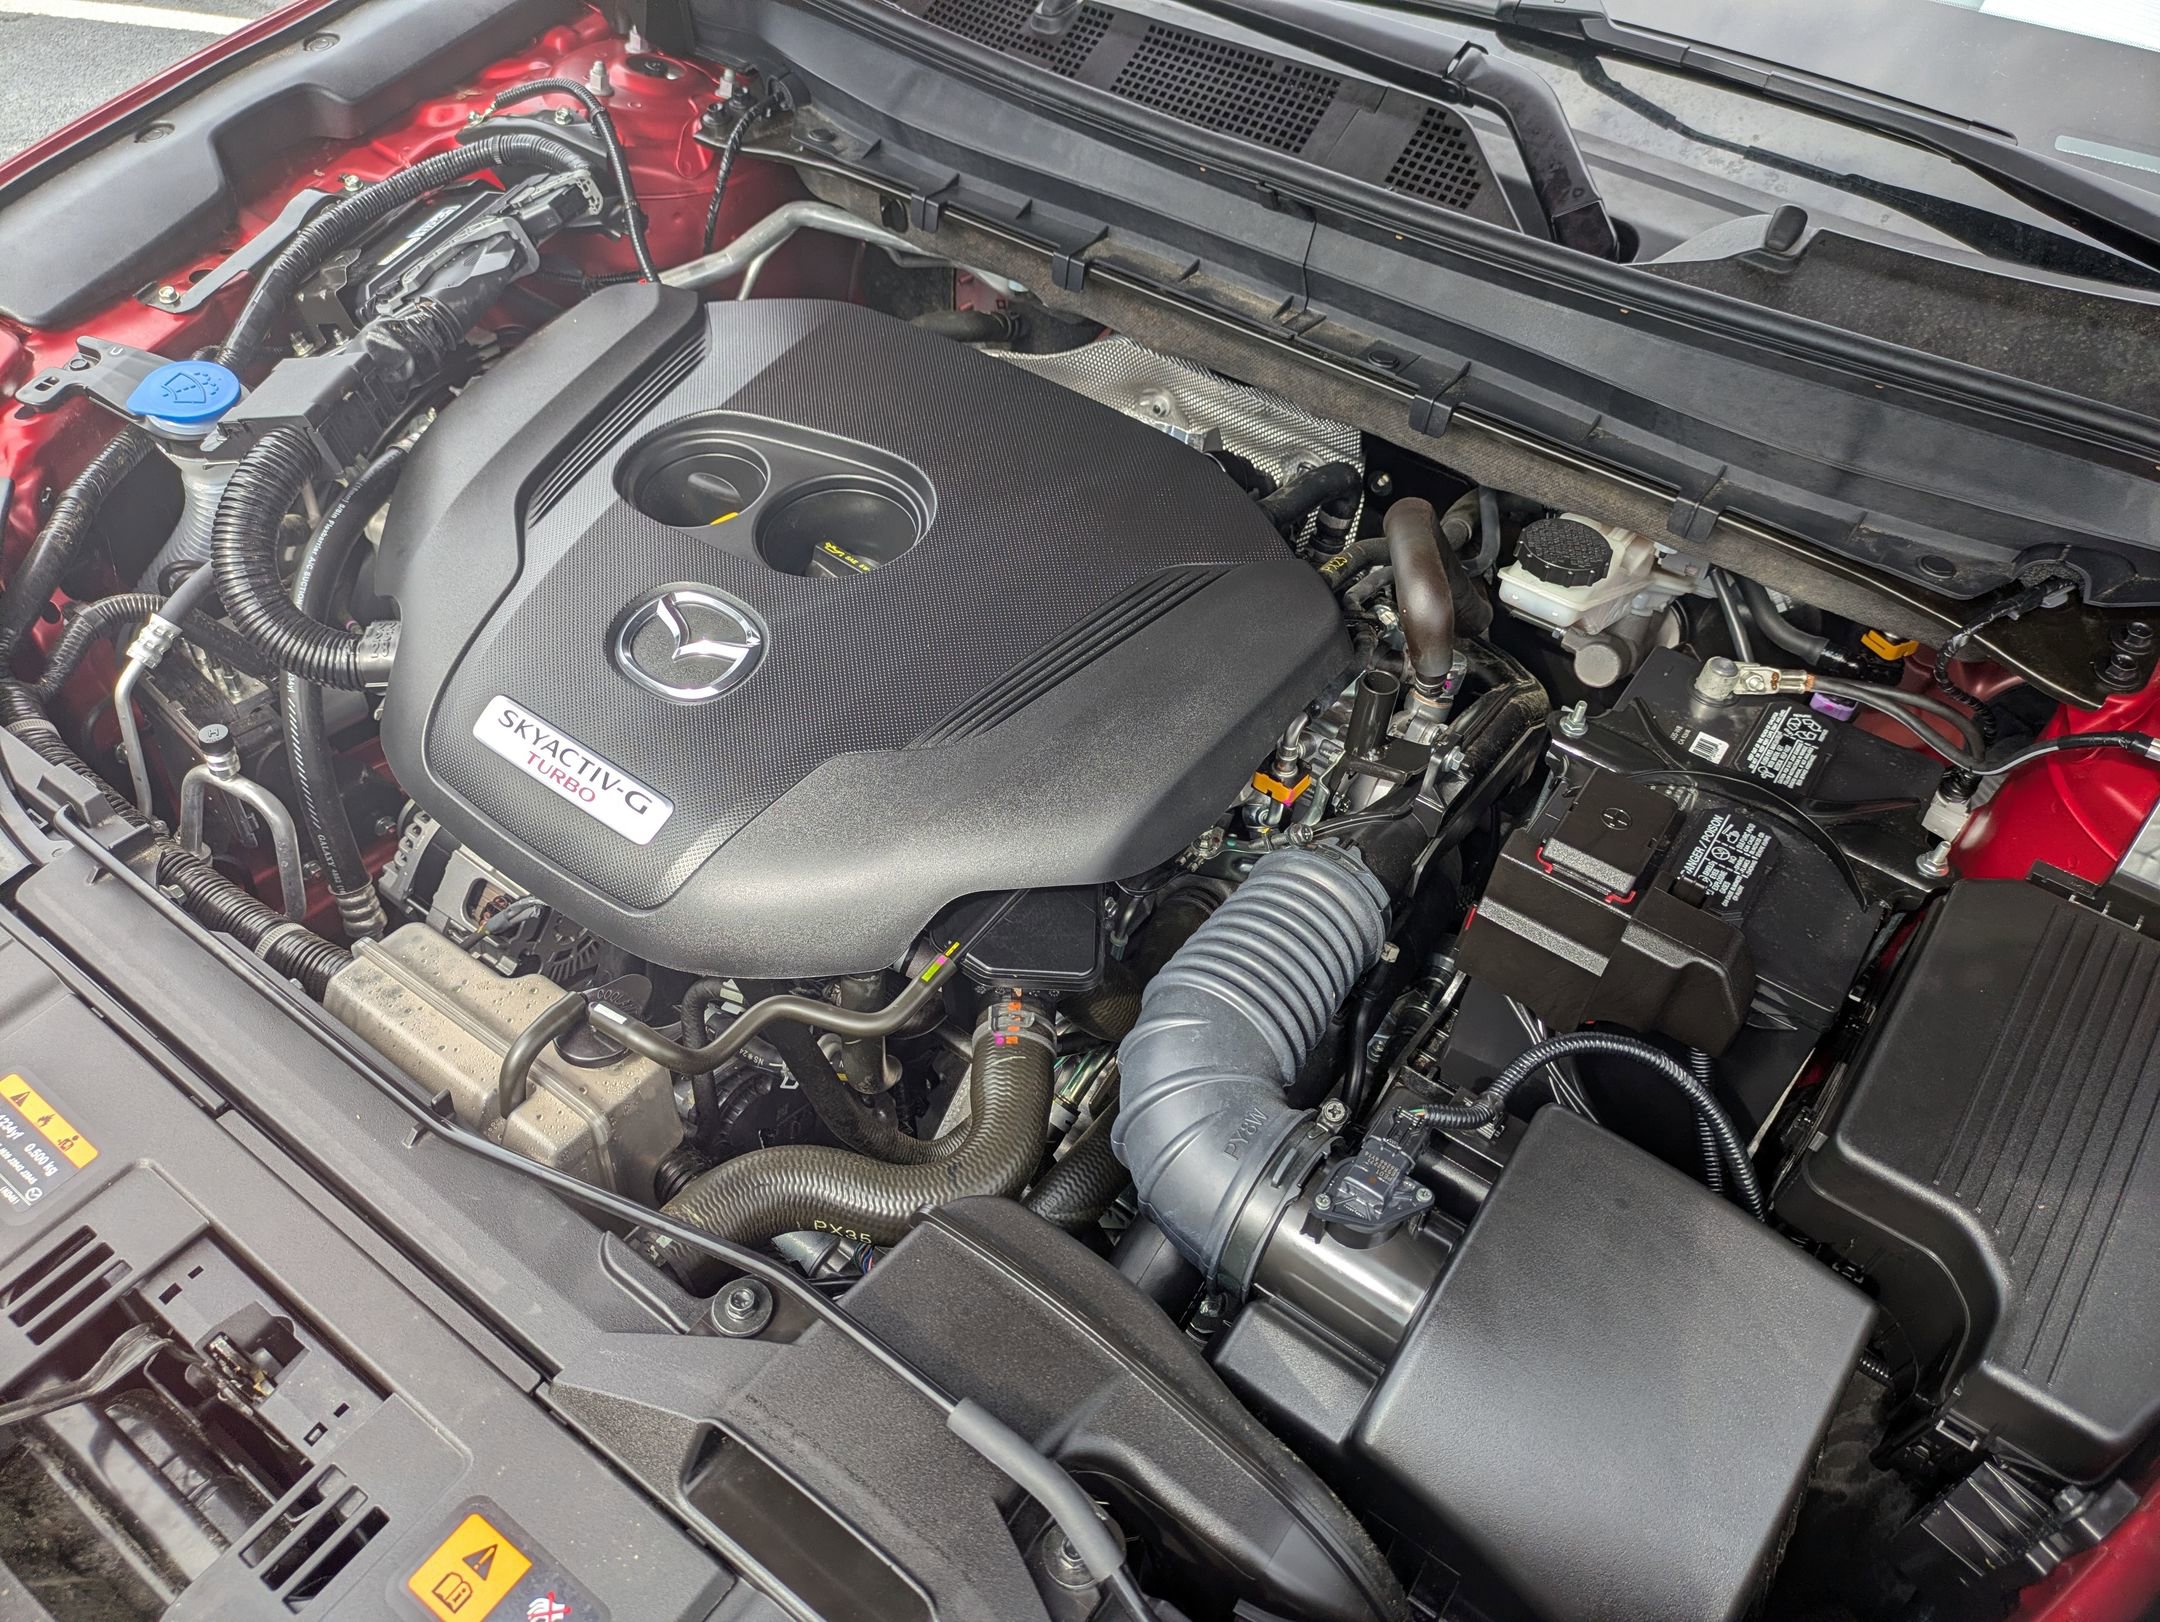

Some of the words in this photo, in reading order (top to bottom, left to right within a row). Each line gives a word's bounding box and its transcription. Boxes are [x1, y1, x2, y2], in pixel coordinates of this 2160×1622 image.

[498, 709, 653, 816] SKYACTIV-G
[526, 751, 596, 803] TURBO
[1703, 814, 1724, 843] POISON
[318, 834, 336, 867] GALAXY
[1223, 1107, 1270, 1161] PY8W
[24, 1143, 50, 1165] 0.500
[43, 1161, 58, 1177] kg
[814, 1220, 872, 1244] PX35
